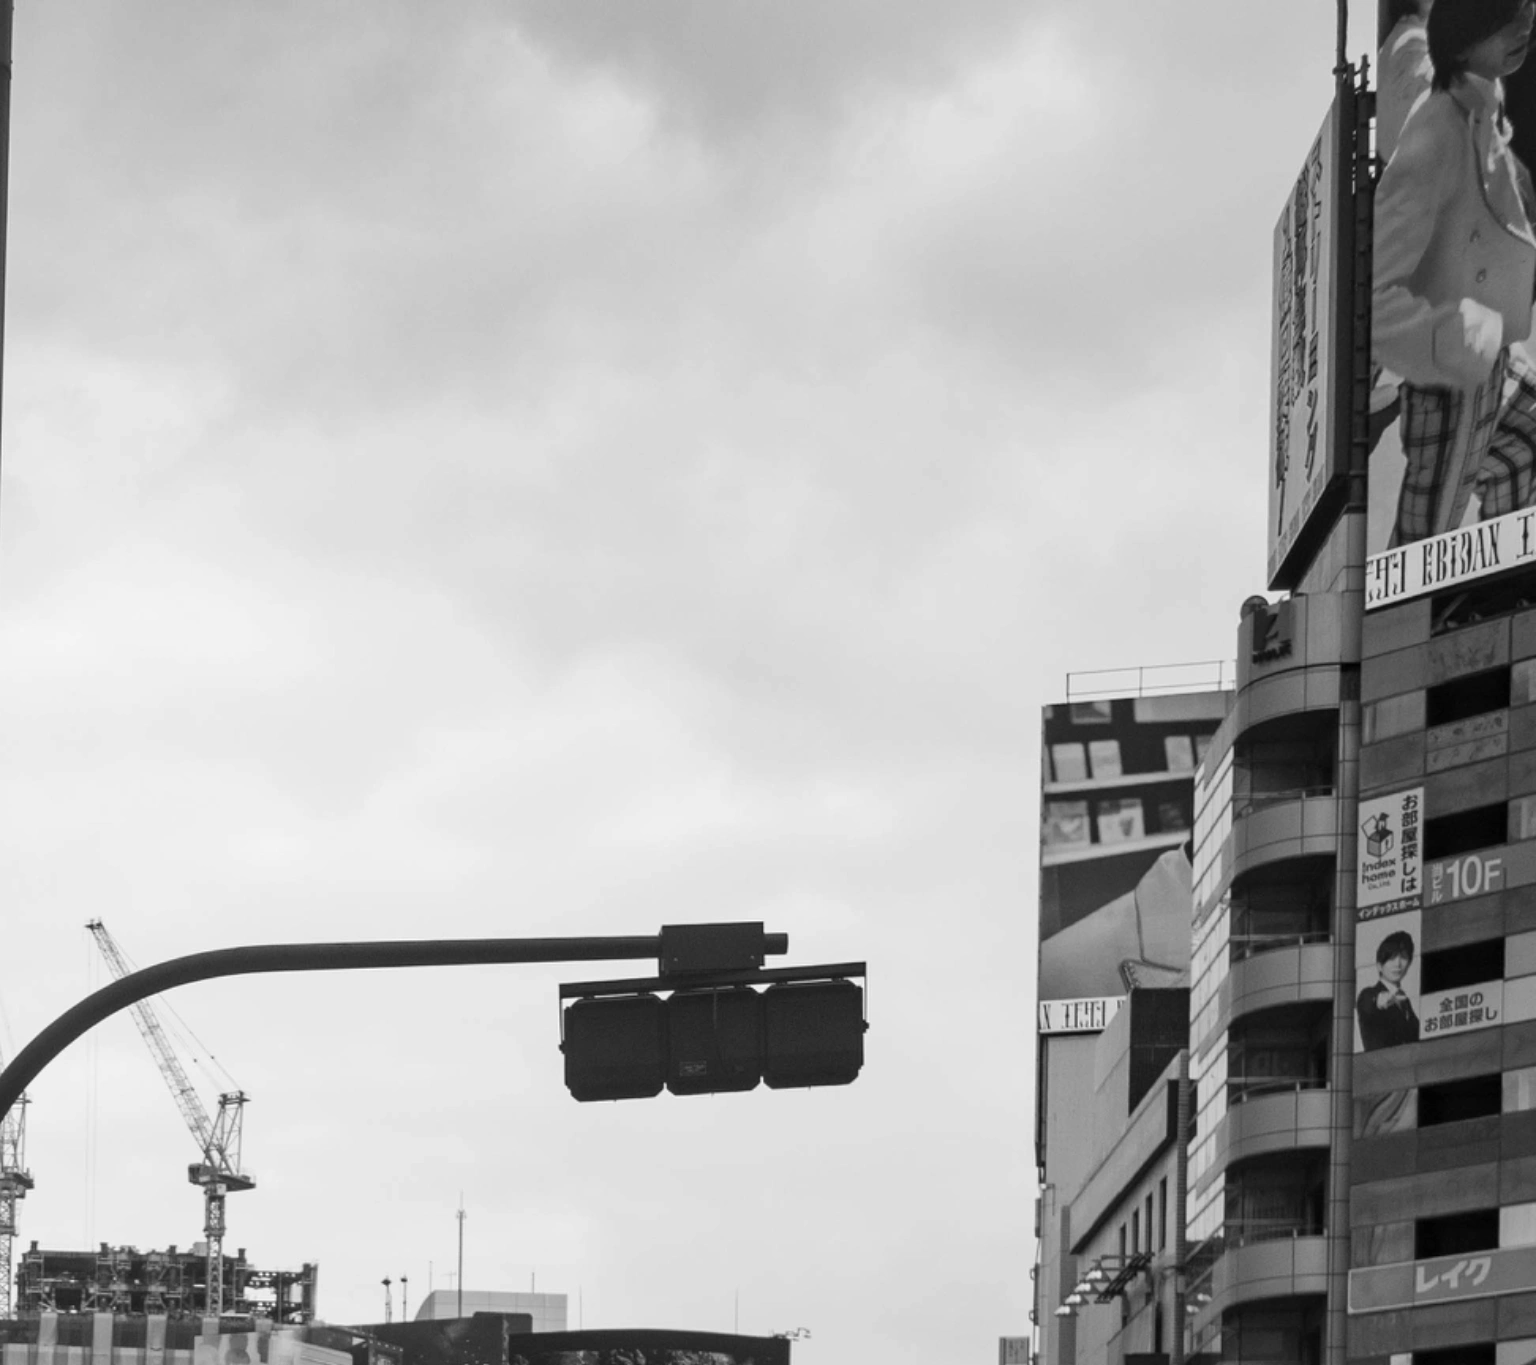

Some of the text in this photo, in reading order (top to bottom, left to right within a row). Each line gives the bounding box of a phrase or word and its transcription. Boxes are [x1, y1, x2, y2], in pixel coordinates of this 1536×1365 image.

[1401, 795, 1418, 893] お部屋探しは
[1446, 855, 1501, 898] 10F
[1425, 1006, 1498, 1031] お部屋探し
[1439, 992, 1483, 1013] 全国の
[1416, 1256, 1492, 1293] レイク
